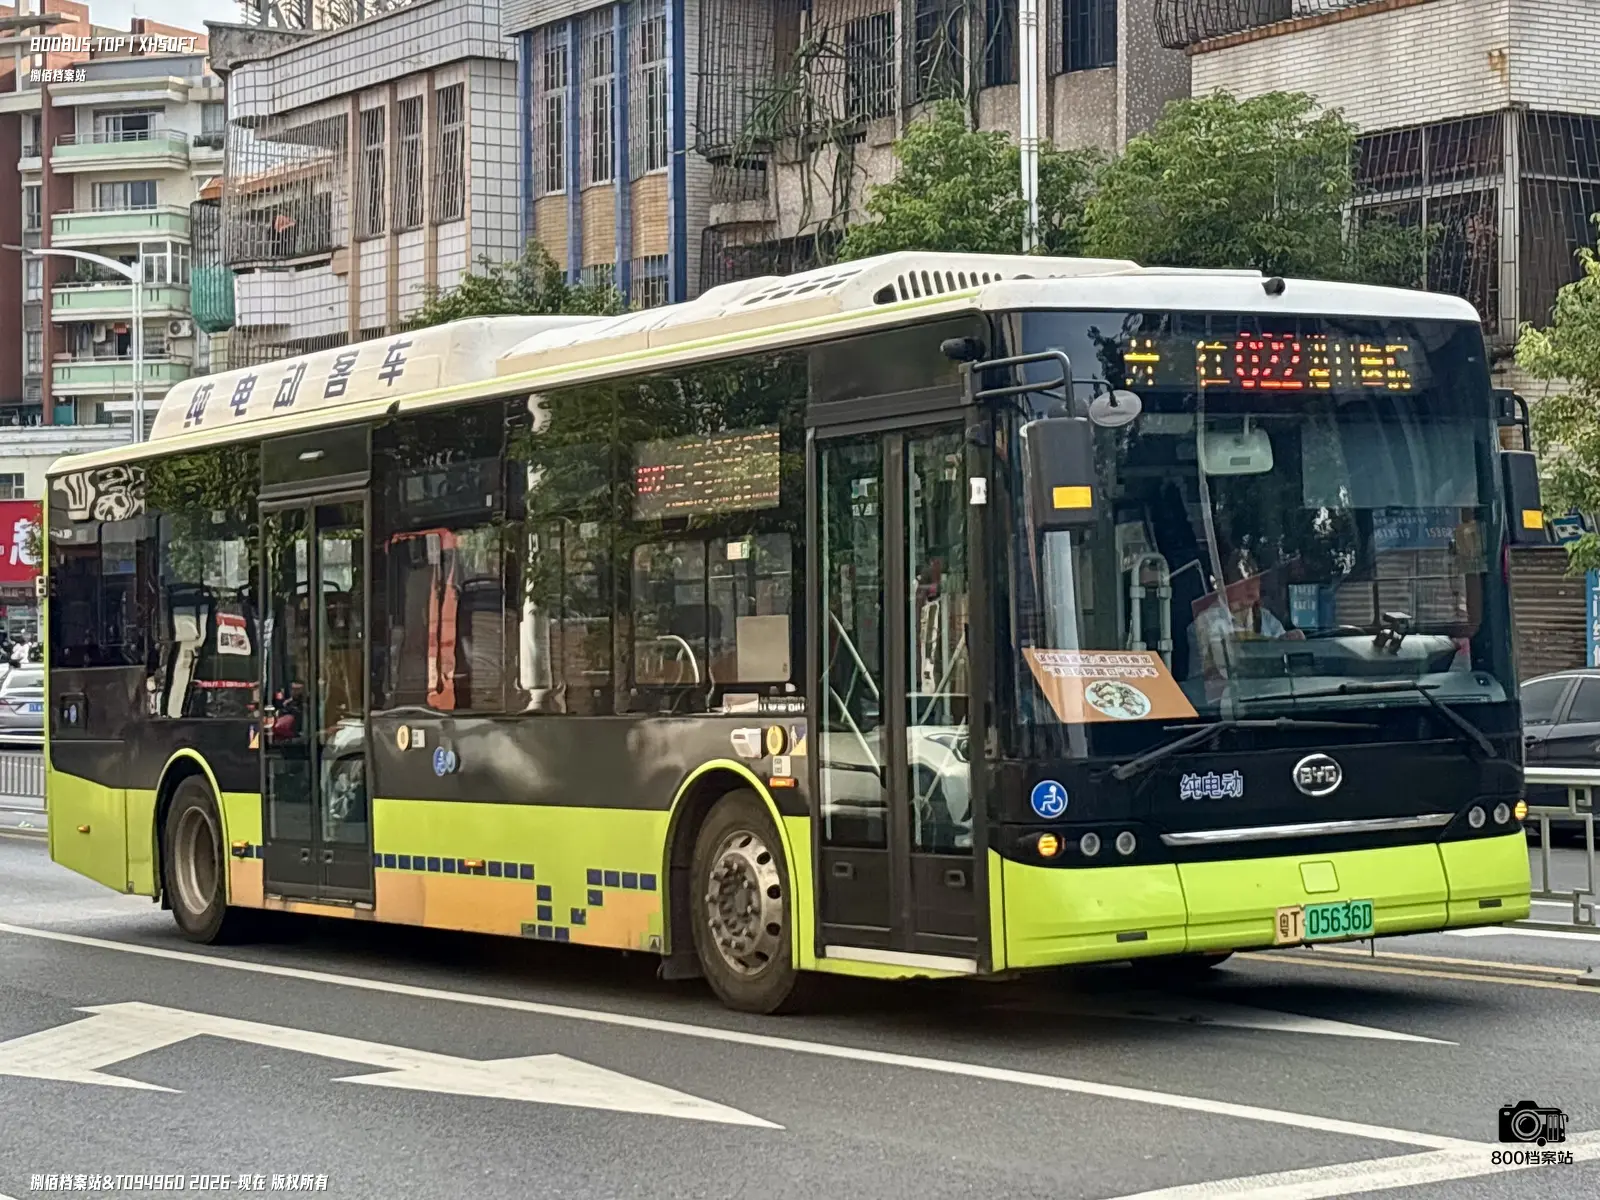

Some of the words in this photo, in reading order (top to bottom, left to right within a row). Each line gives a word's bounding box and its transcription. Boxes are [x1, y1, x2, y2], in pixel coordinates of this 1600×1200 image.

[183, 340, 413, 428] 纯电动客车
[1180, 770, 1244, 800] 纯电动
